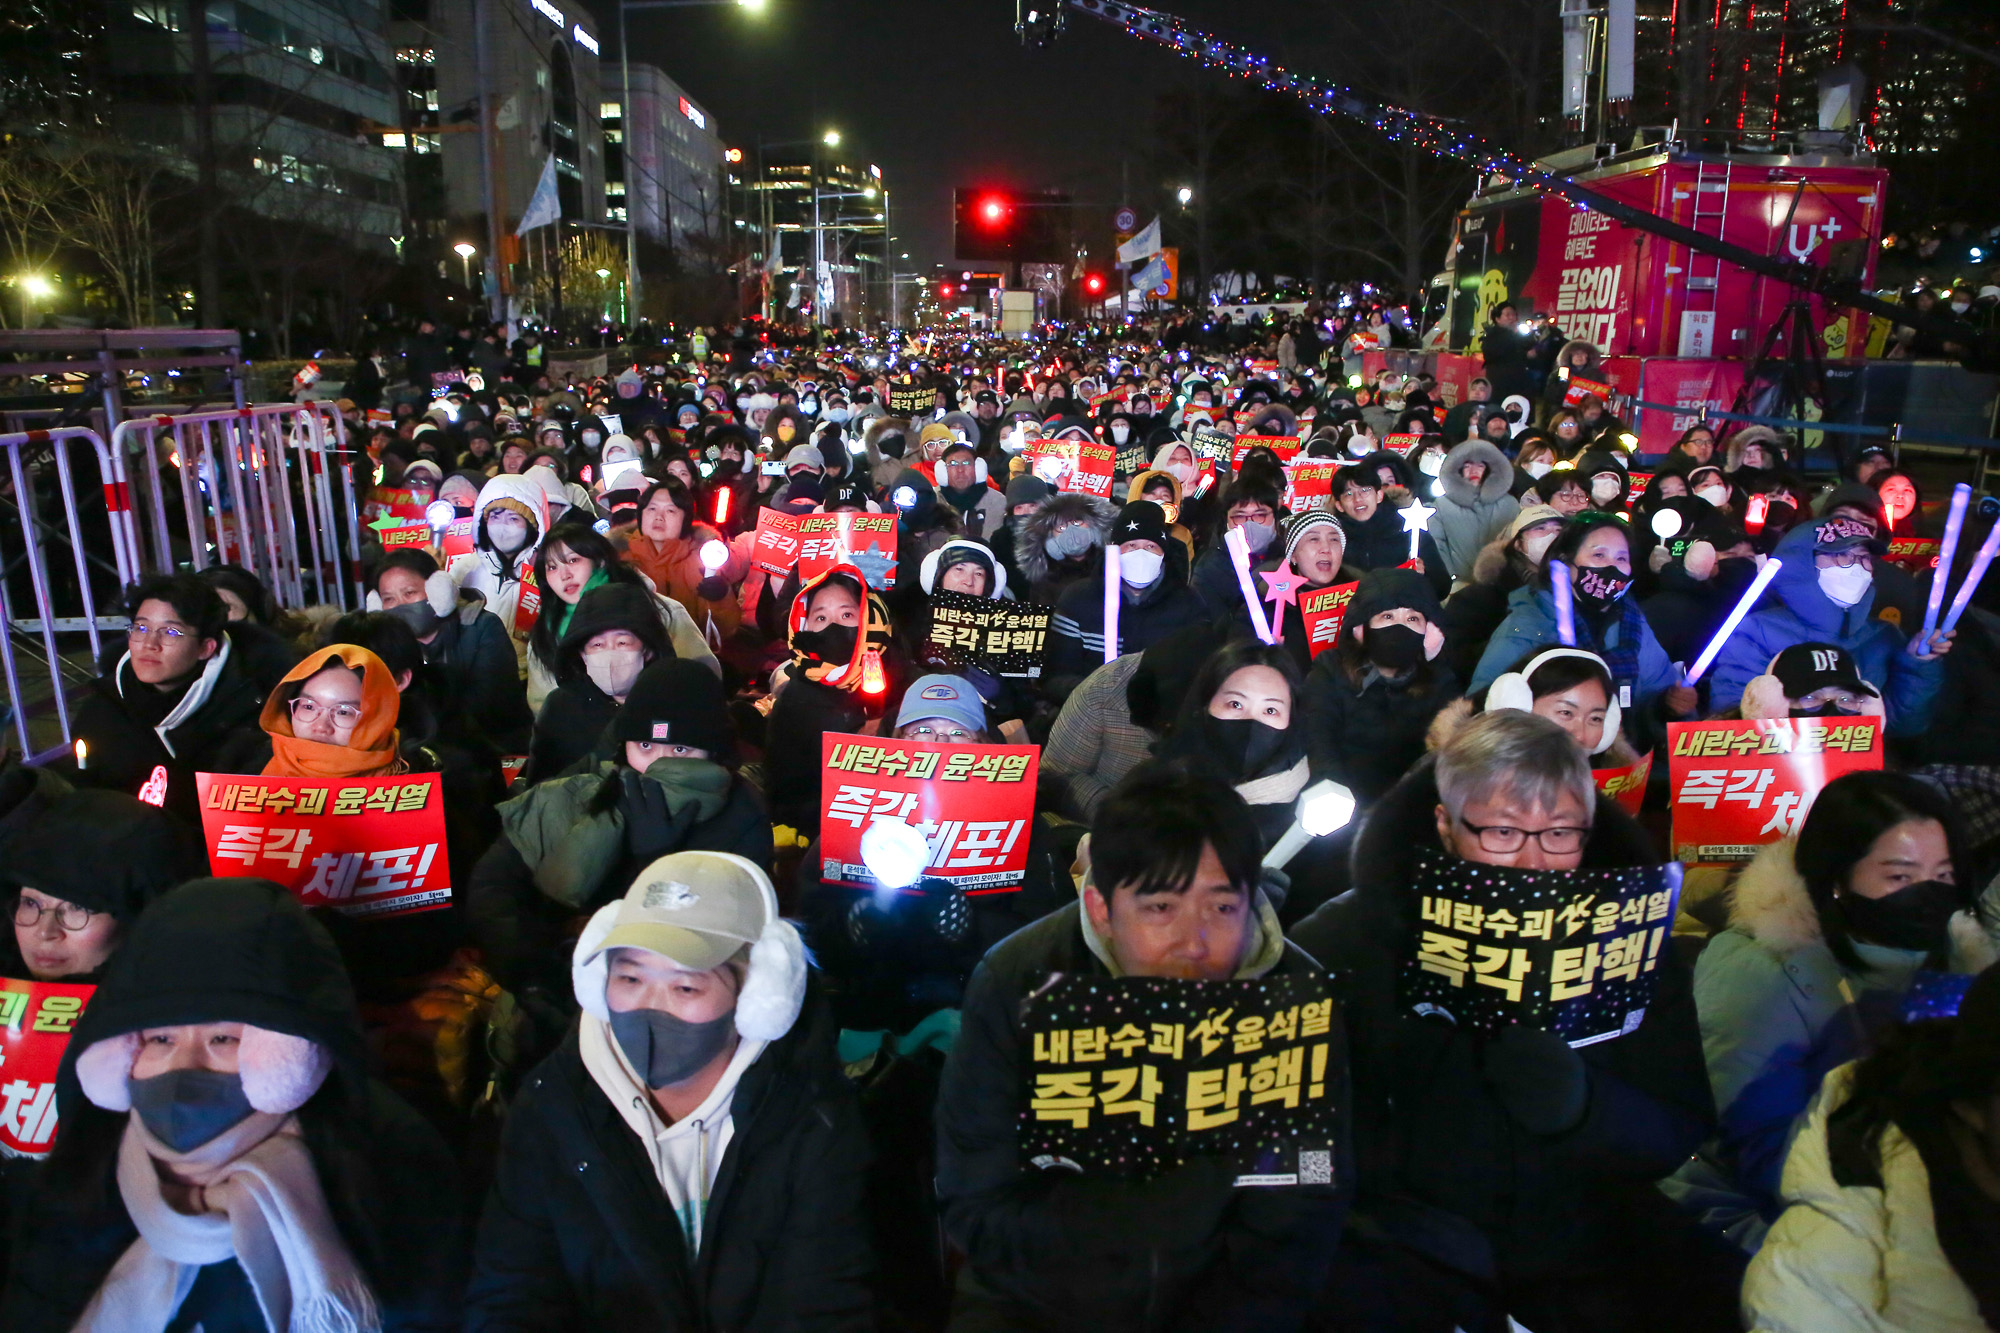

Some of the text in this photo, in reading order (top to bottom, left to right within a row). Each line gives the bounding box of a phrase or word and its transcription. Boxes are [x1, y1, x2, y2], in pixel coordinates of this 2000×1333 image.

[1119, 215, 1132, 226] 30
[1564, 236, 1597, 261] 혜택도
[1556, 264, 1622, 311] 끝없이
[891, 399, 911, 411] 즉각
[1079, 445, 1113, 462] 윤석열
[1236, 437, 1271, 448] 내란수괴
[1271, 440, 1299, 450] 윤석열
[1067, 473, 1112, 495] 탄핵!
[1299, 468, 1333, 481] 윤석열
[385, 529, 431, 545] 내란수괴
[447, 521, 473, 537] 석열
[852, 517, 893, 533] 윤석열
[758, 530, 799, 556] 즉각
[800, 538, 842, 561] 즉각
[1888, 542, 1917, 555] 수괴
[1305, 588, 1355, 615] 내란수
[933, 607, 1049, 629] 내란수괴 윤석열
[1312, 616, 1344, 644] 즉
[930, 623, 1046, 654] 즉각 탄핵!
[1673, 724, 1876, 757] 내란수괴 윤석열
[827, 743, 1032, 783] 내란수괴 윤석열
[206, 781, 432, 815] 내란수괴 윤석열
[1677, 768, 1776, 810] 즉각
[827, 783, 920, 829] 즉각
[216, 824, 313, 870] 즉각
[301, 842, 439, 899] 체포!
[1421, 887, 1673, 941] 내란수괴 윤석열
[1417, 925, 1666, 1003] 즉각 탄핵!
[1033, 997, 1334, 1065] 내란수괴 윤석열
[1030, 1042, 1330, 1132] 즉각 탄핵!
